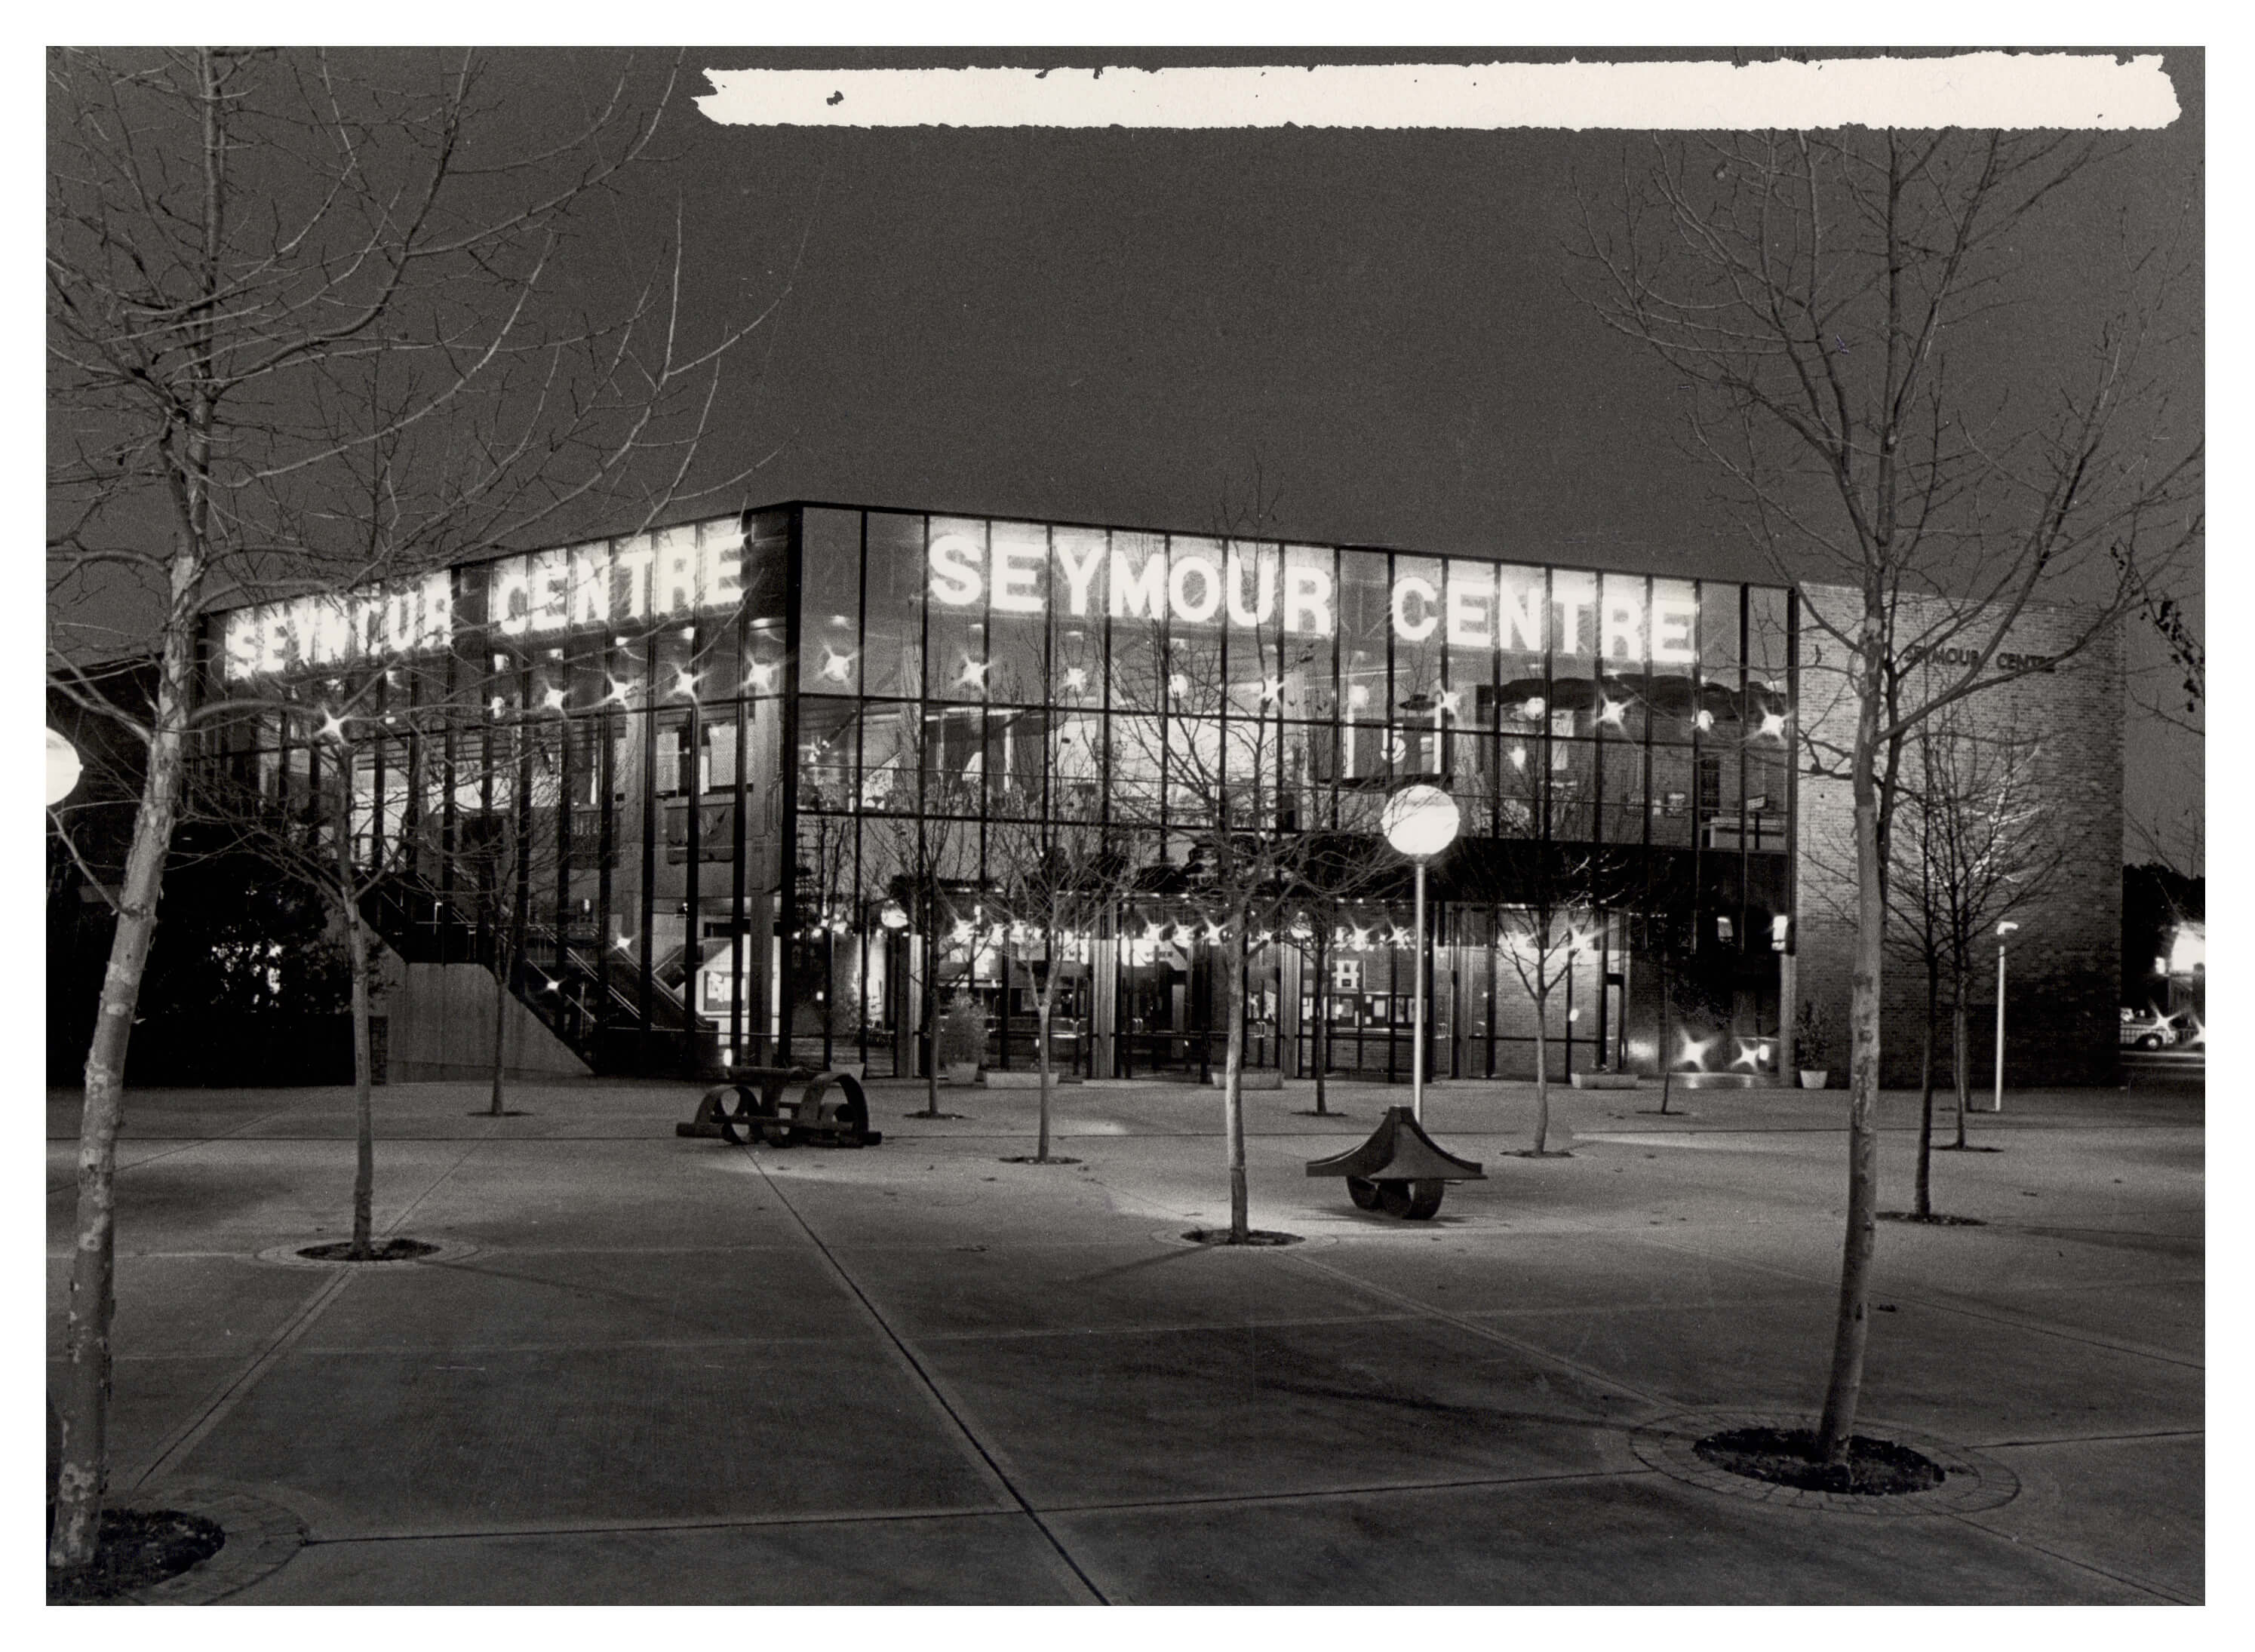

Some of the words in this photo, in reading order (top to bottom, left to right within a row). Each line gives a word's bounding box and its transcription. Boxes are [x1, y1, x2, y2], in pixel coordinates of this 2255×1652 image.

[491, 533, 744, 635] CENTRE
[929, 533, 1334, 636] SEYMOUR
[1392, 576, 1696, 663] CENTRE
